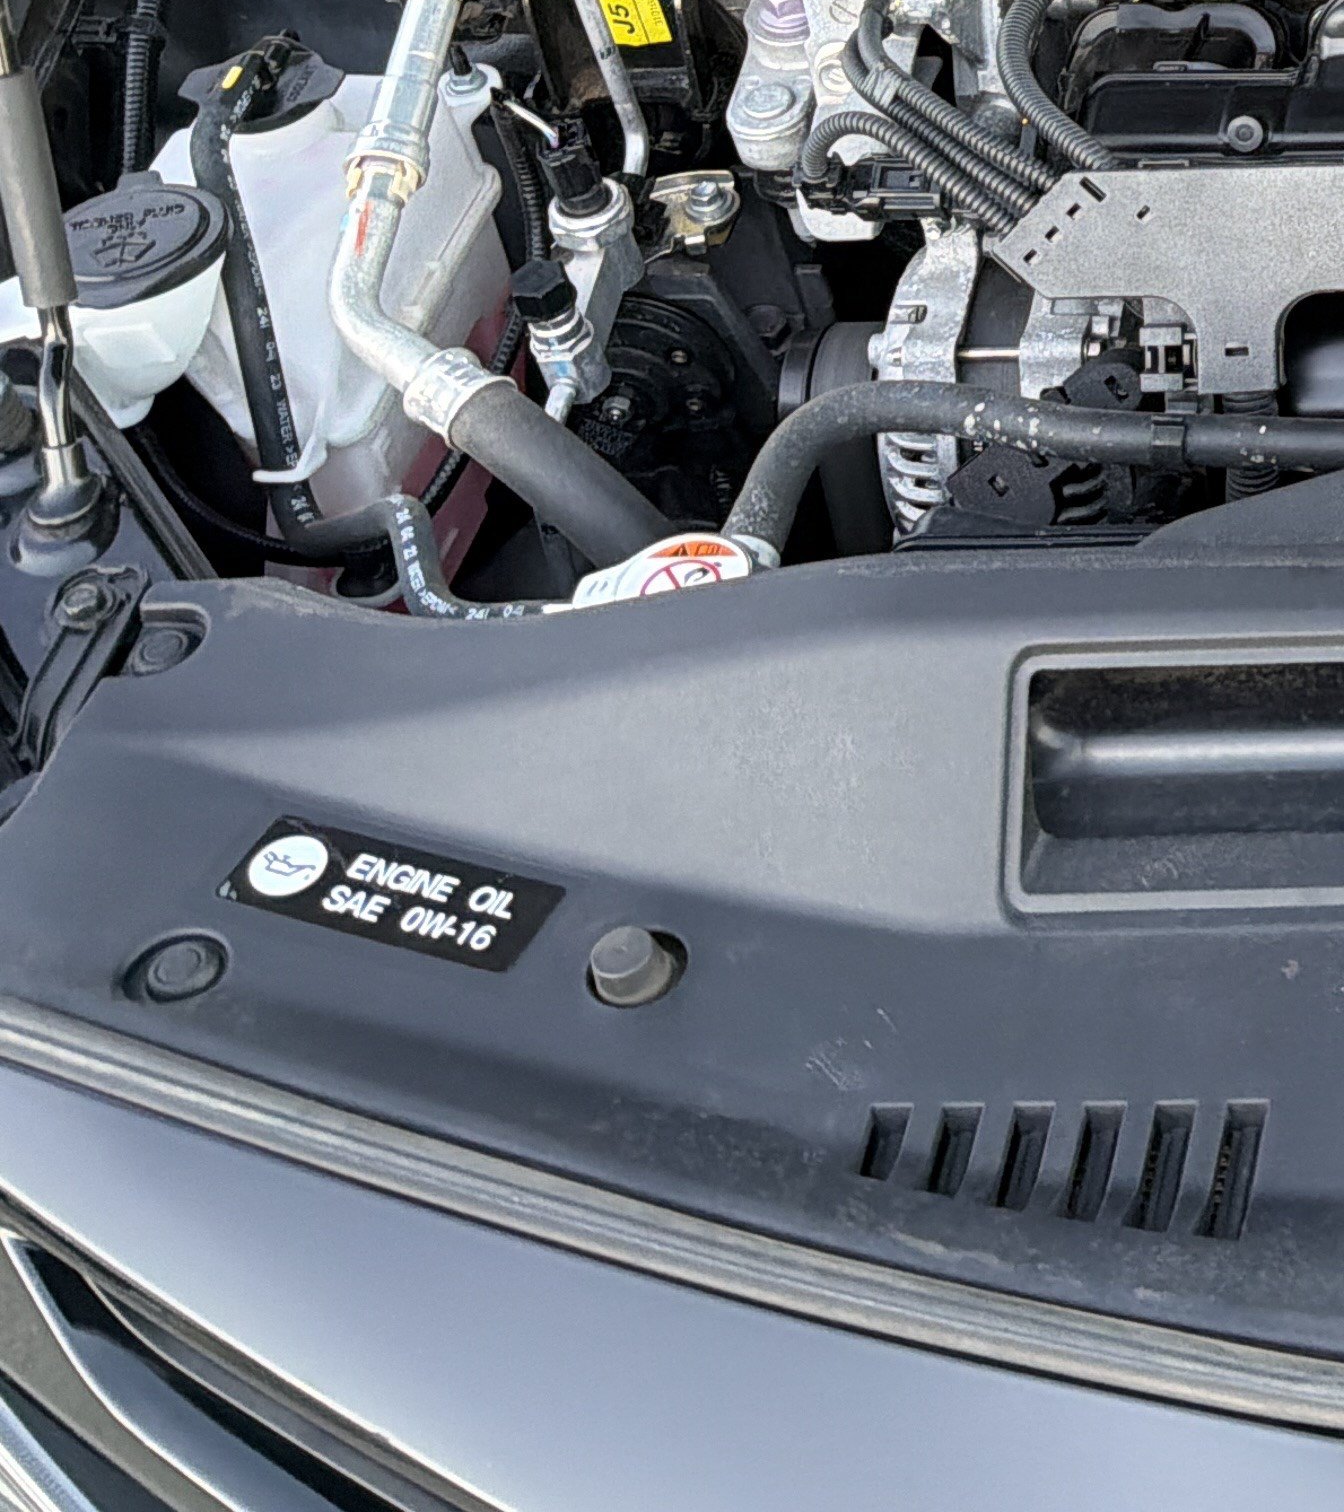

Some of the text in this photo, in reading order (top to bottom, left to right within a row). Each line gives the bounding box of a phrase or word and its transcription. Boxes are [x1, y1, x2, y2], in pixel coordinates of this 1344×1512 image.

[608, 3, 635, 34] J5
[276, 399, 295, 444] WATER
[345, 853, 515, 919] ENGINE OIL
[321, 885, 497, 951] SAE 0W-16
